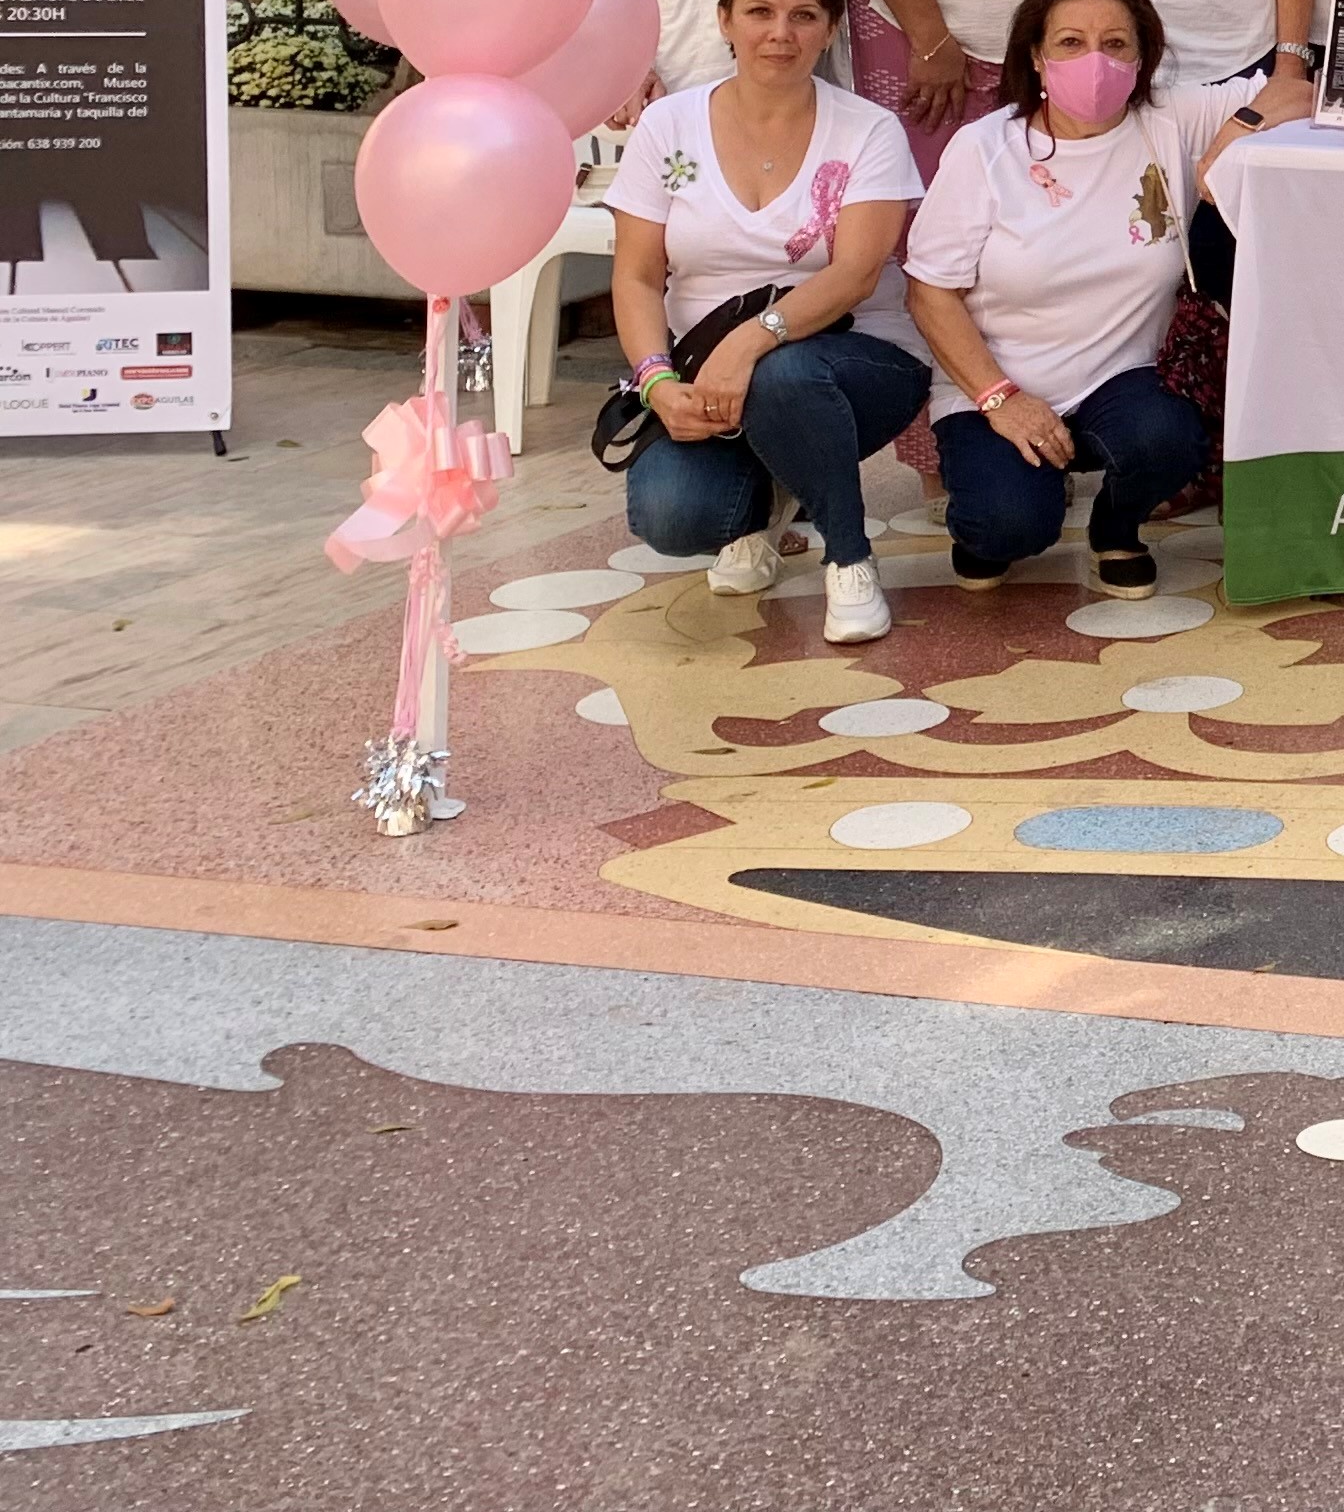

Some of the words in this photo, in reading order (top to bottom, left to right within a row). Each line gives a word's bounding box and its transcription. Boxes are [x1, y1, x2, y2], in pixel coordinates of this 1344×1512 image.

[7, 7, 66, 21] 20:30H
[36, 63, 47, 74] A
[58, 62, 97, 75] través
[107, 62, 125, 74] de
[135, 62, 147, 74] la
[103, 77, 147, 89] Museo
[19, 92, 31, 104] la
[33, 92, 80, 104] Cultura
[64, 109, 74, 121] y
[76, 107, 124, 120] taquilla
[127, 106, 148, 118] del
[27, 138, 51, 150] 638
[52, 138, 76, 150] 939
[78, 138, 102, 149] 200
